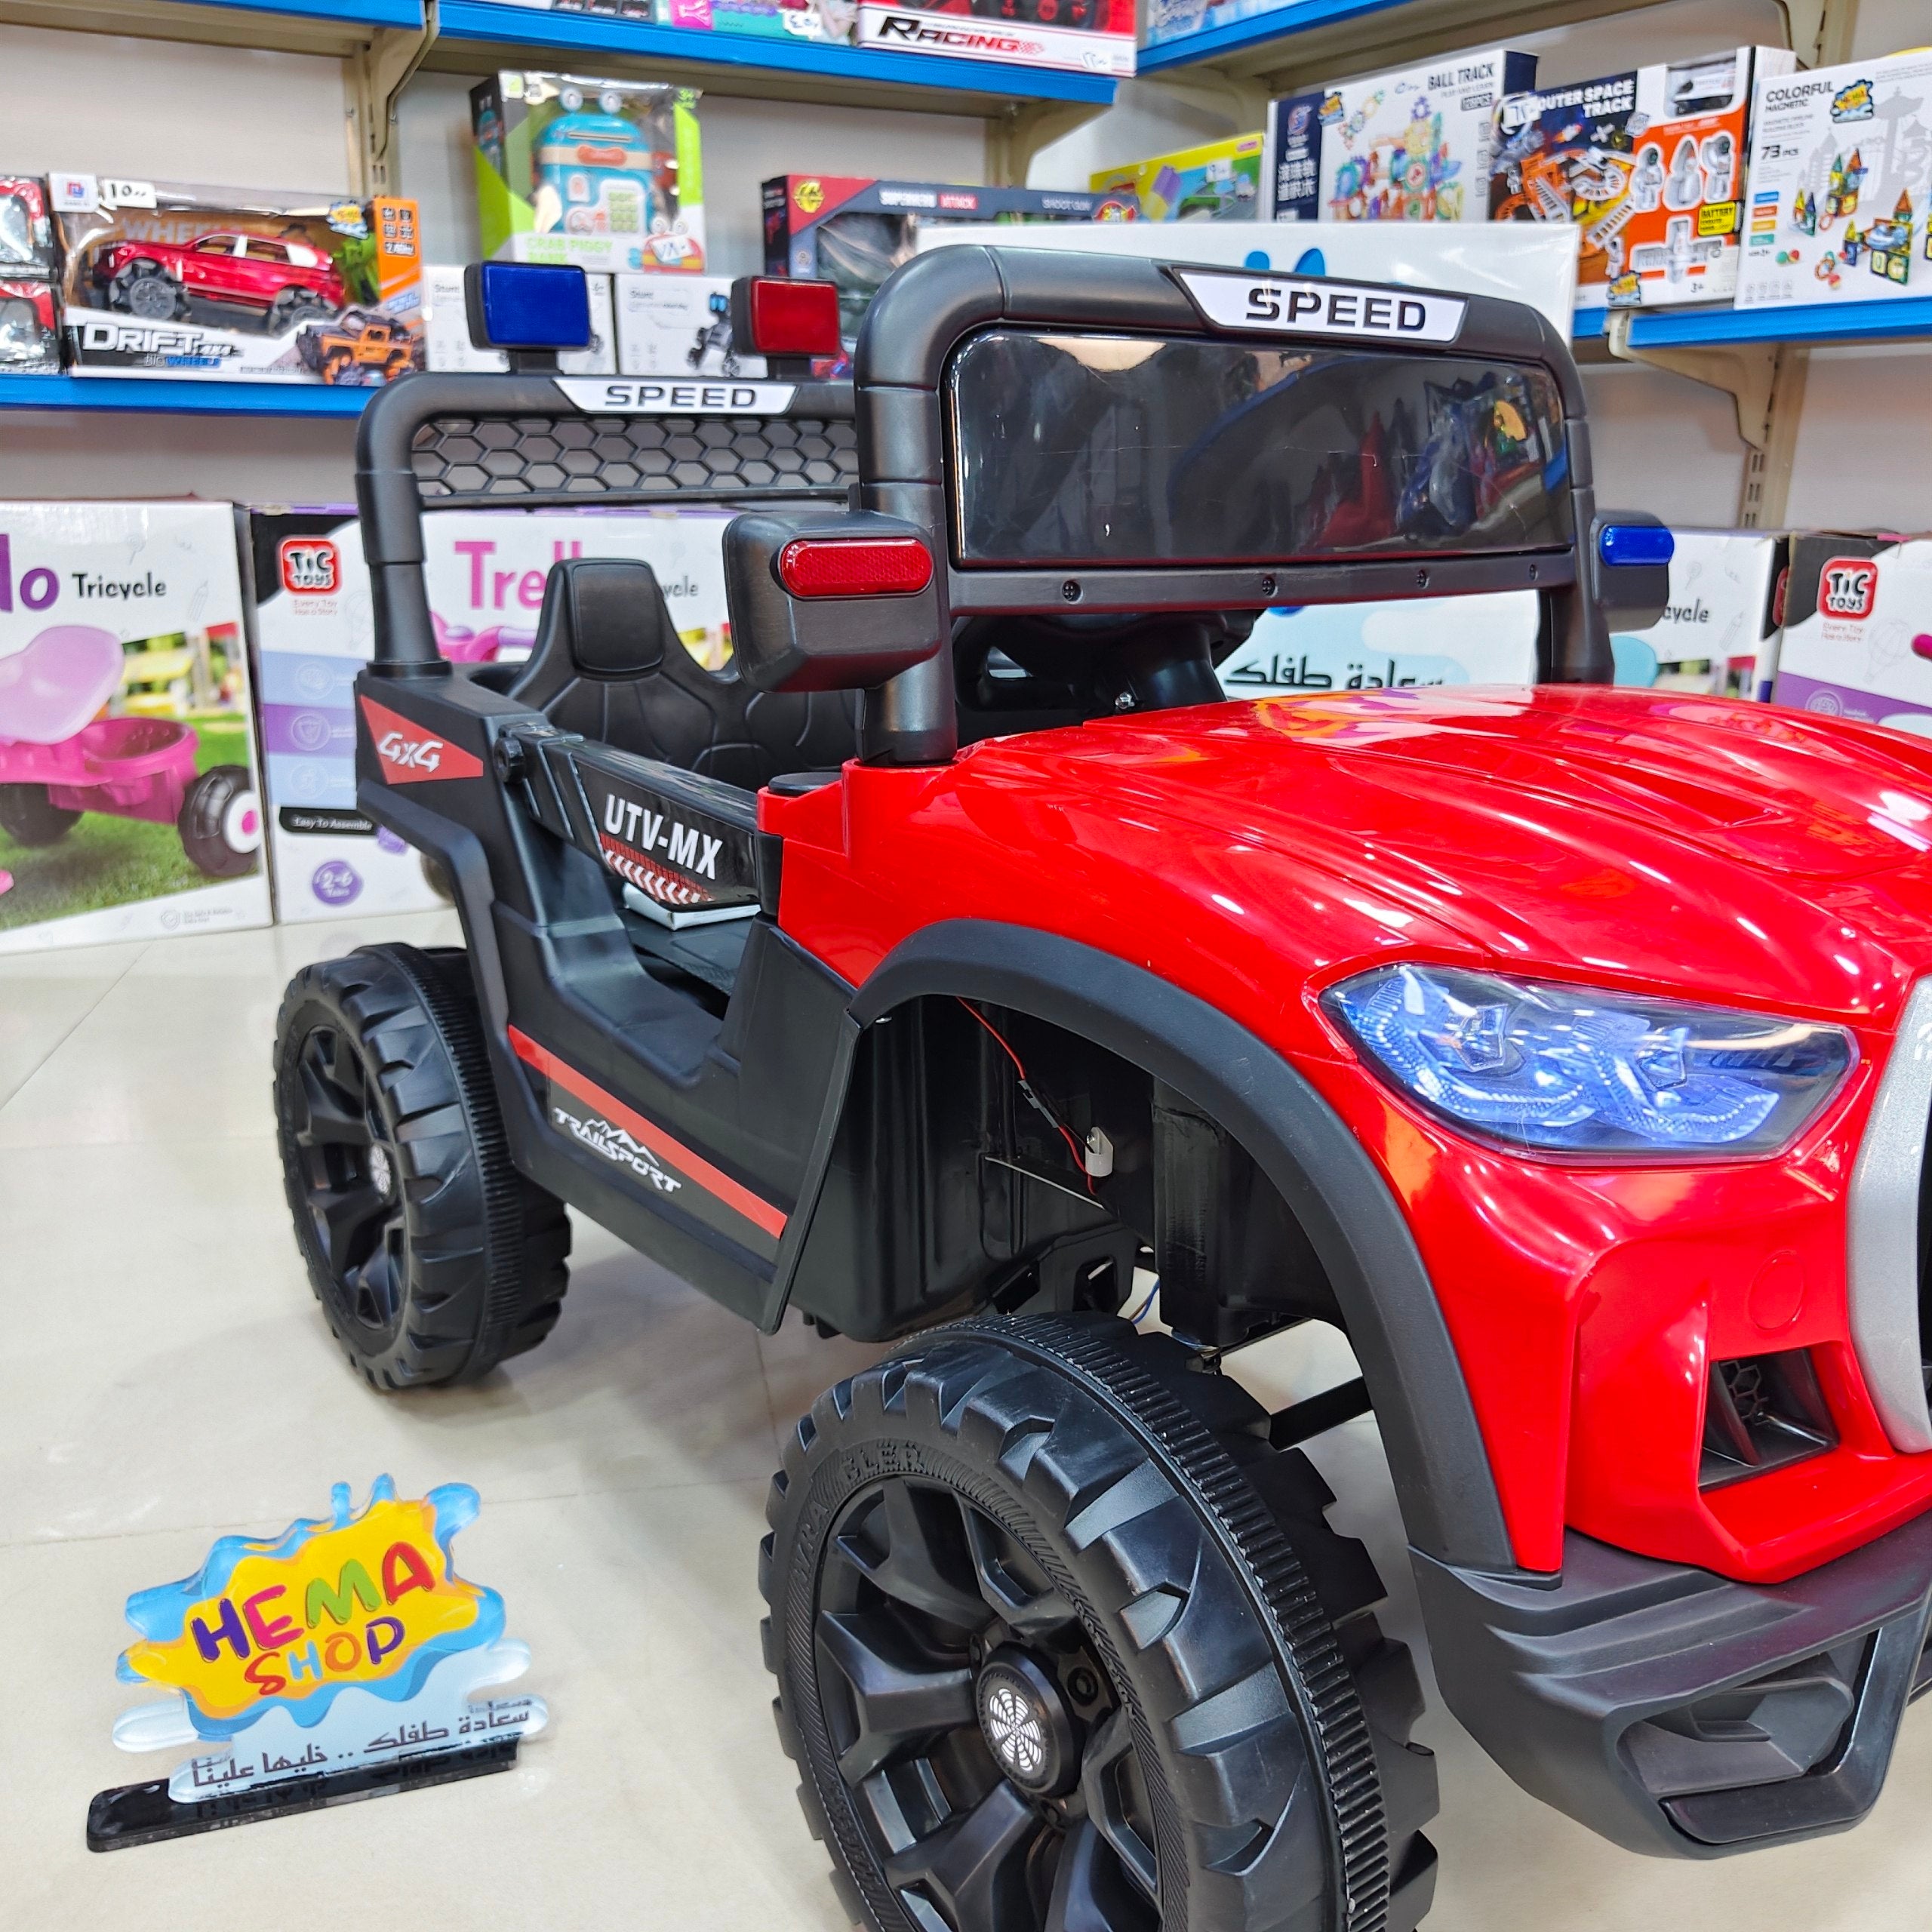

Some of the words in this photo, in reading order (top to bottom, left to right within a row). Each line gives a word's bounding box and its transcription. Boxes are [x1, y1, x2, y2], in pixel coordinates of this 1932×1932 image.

[878, 16, 1020, 53] RACING
[1427, 73, 1454, 91] BALL
[1457, 63, 1495, 84] TRACK
[1584, 79, 1635, 102] SPACE
[1766, 81, 1835, 103] COLORFUL
[1583, 97, 1634, 118] TRACK
[1765, 99, 1809, 112] MAGNETIC
[1761, 144, 1780, 160] 73
[1245, 288, 1426, 332] SPEED
[82, 321, 204, 355] DRIFT
[605, 385, 757, 409] SPEED
[0, 532, 60, 611] lo
[72, 571, 167, 601] Tricycle
[1662, 598, 1709, 624] cycle
[1829, 597, 1863, 611] TOYS
[1224, 653, 1333, 688] طفلك
[605, 794, 723, 881] UTV-MX
[552, 1106, 682, 1192] TRAILSPORT
[190, 1541, 436, 1663] HEMA
[245, 1615, 405, 1696] SHOP
[363, 1720, 450, 1755] طفلك
[457, 1709, 531, 1737] سعادة
[191, 1758, 255, 1789] علينا
[262, 1743, 328, 1774] خليها
